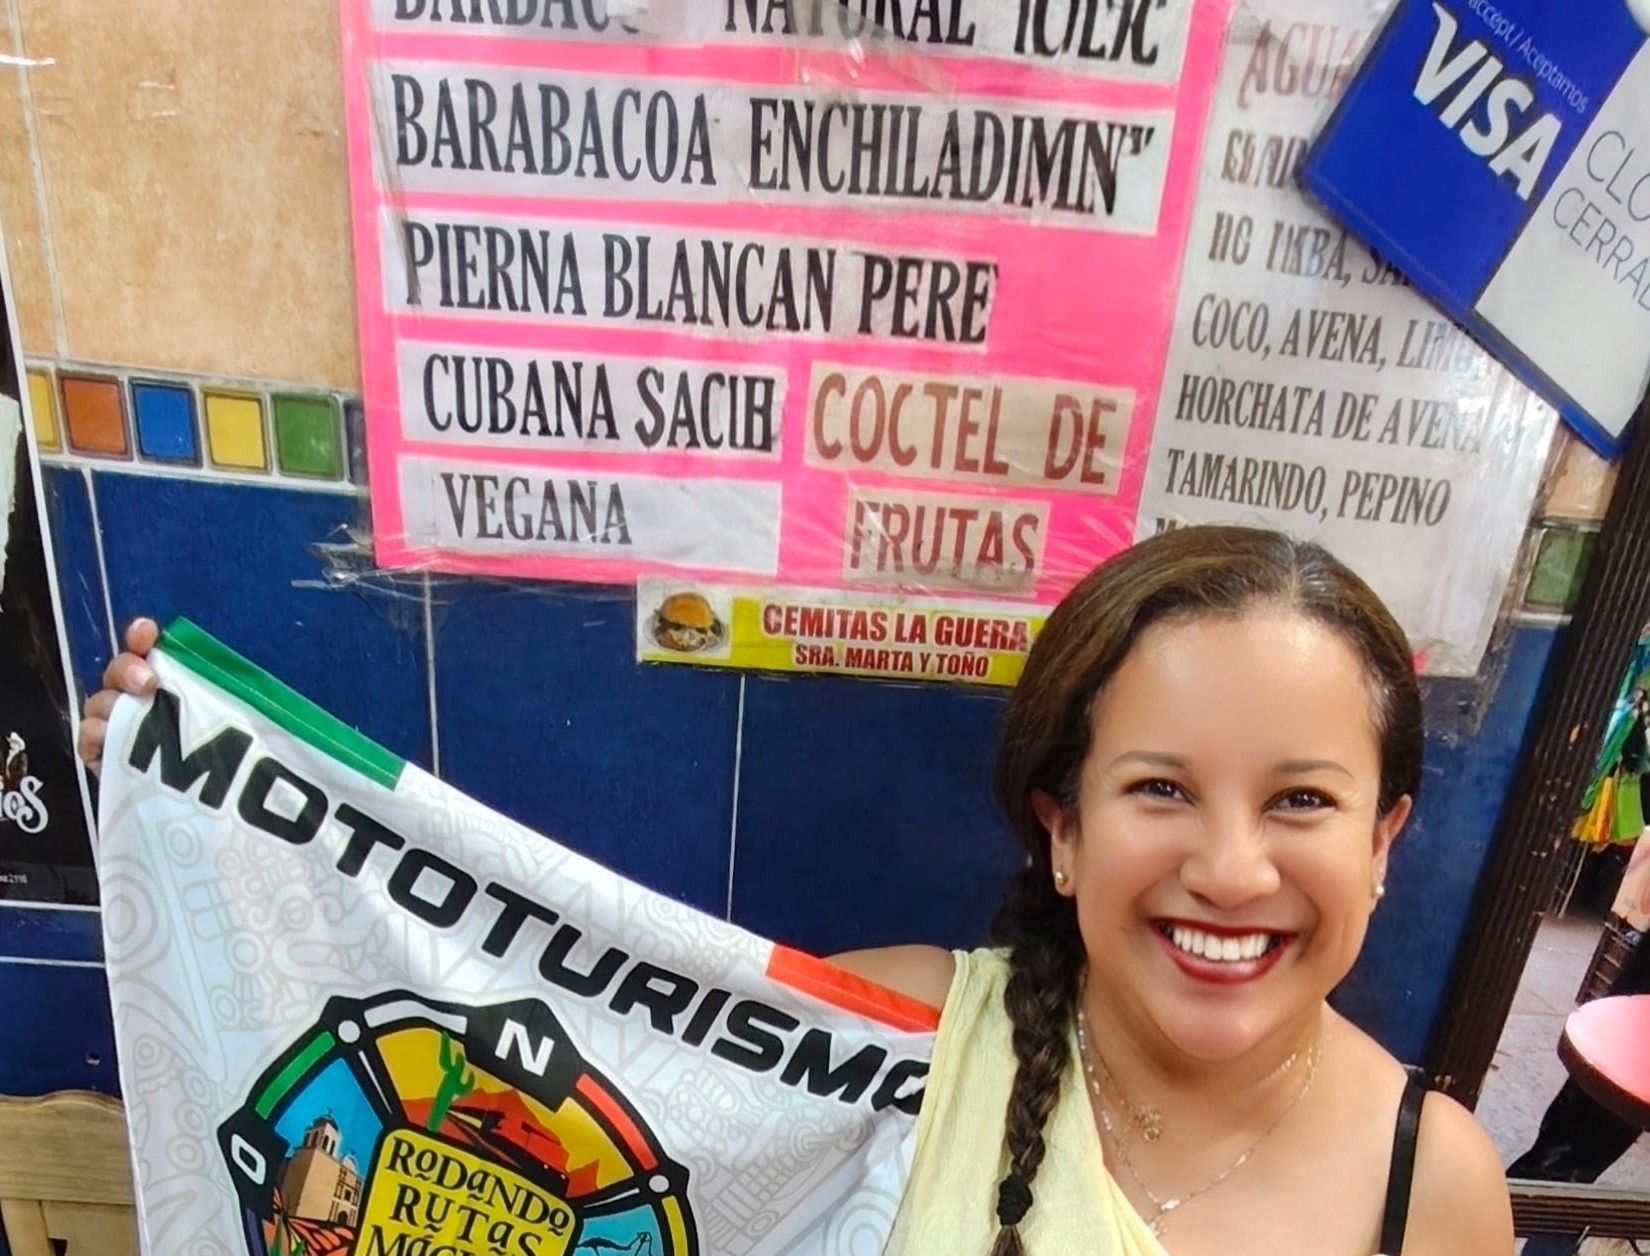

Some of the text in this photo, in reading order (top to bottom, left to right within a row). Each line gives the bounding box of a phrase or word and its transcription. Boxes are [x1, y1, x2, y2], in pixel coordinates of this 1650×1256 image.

[391, 74, 717, 185] BARABACOA
[1413, 2, 1562, 201] VISA
[404, 221, 588, 316] PIERNA
[601, 233, 836, 333] BLANCAN
[1192, 294, 1270, 360] COCO,
[1280, 308, 1387, 373] AVENA,
[423, 353, 620, 440] CUBANA
[813, 372, 1117, 484] COCTEL DE
[1175, 374, 1324, 436] HORCHATA
[1332, 391, 1379, 443] DE
[440, 472, 632, 546] VEGANA
[1164, 449, 1452, 527] TAMARINDO, PEPINO
[850, 500, 1040, 576] FRUTAS
[763, 603, 1028, 652] CEMITAS LA GUERA
[795, 644, 989, 678] SRA. MARTA Y TOÑO
[128, 688, 931, 1116] MOTOTURISMO
[495, 1018, 555, 1076] N
[231, 1134, 267, 1186] O
